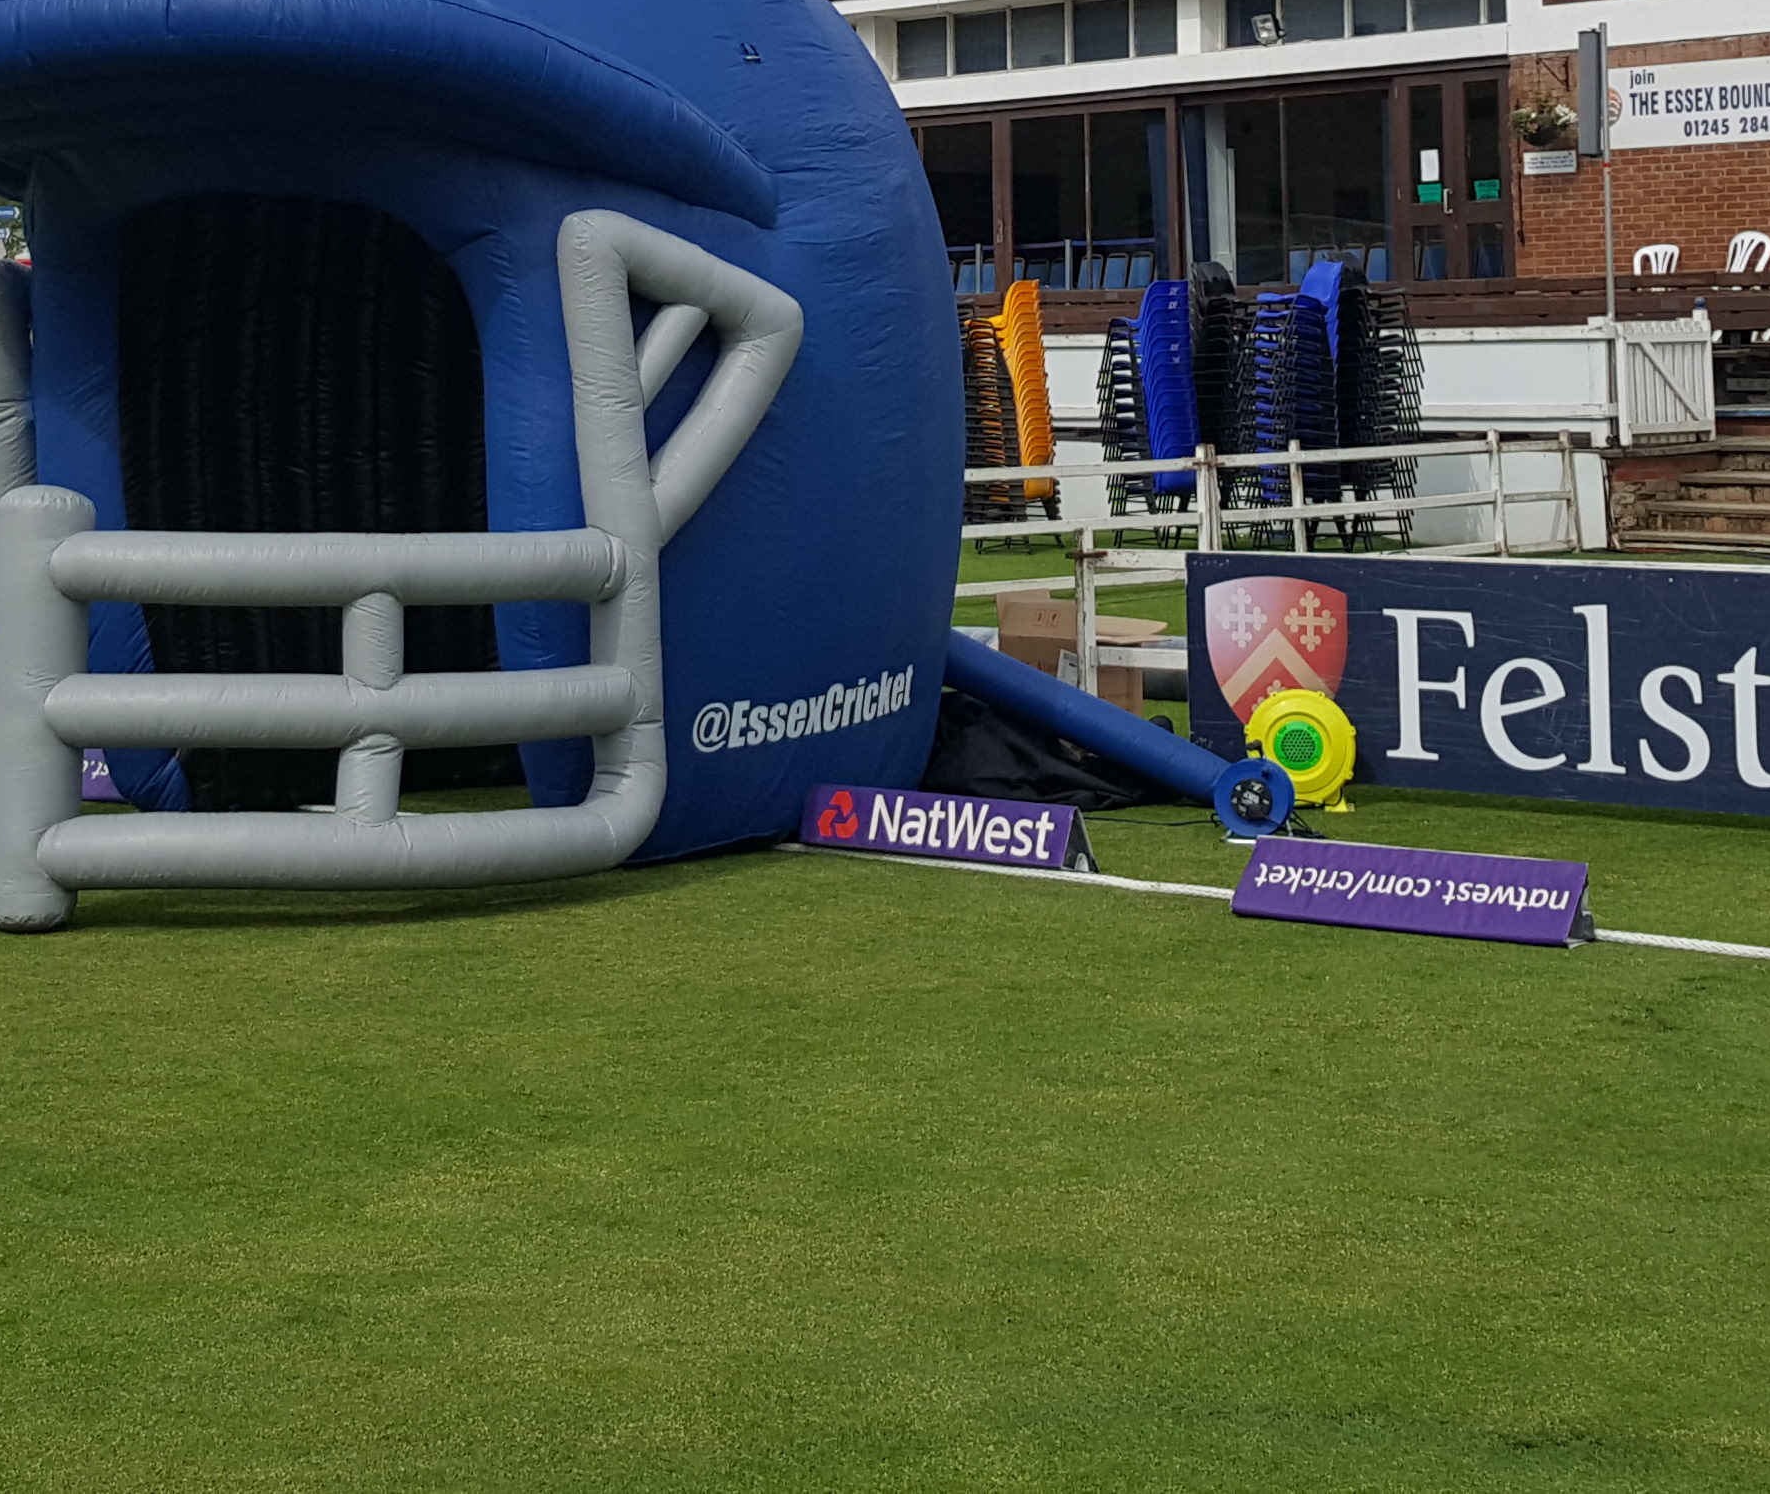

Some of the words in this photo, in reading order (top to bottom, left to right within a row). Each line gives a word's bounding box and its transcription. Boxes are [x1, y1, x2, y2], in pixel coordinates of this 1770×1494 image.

[1630, 69, 1656, 89] join
[1629, 90, 1659, 117] THE
[1665, 86, 1714, 114] ESSEX
[1683, 118, 1730, 138] 01245
[692, 663, 915, 754] @EssexCricket
[867, 793, 1055, 861] NatWest
[1254, 862, 1570, 915] natwest.com/cricket
